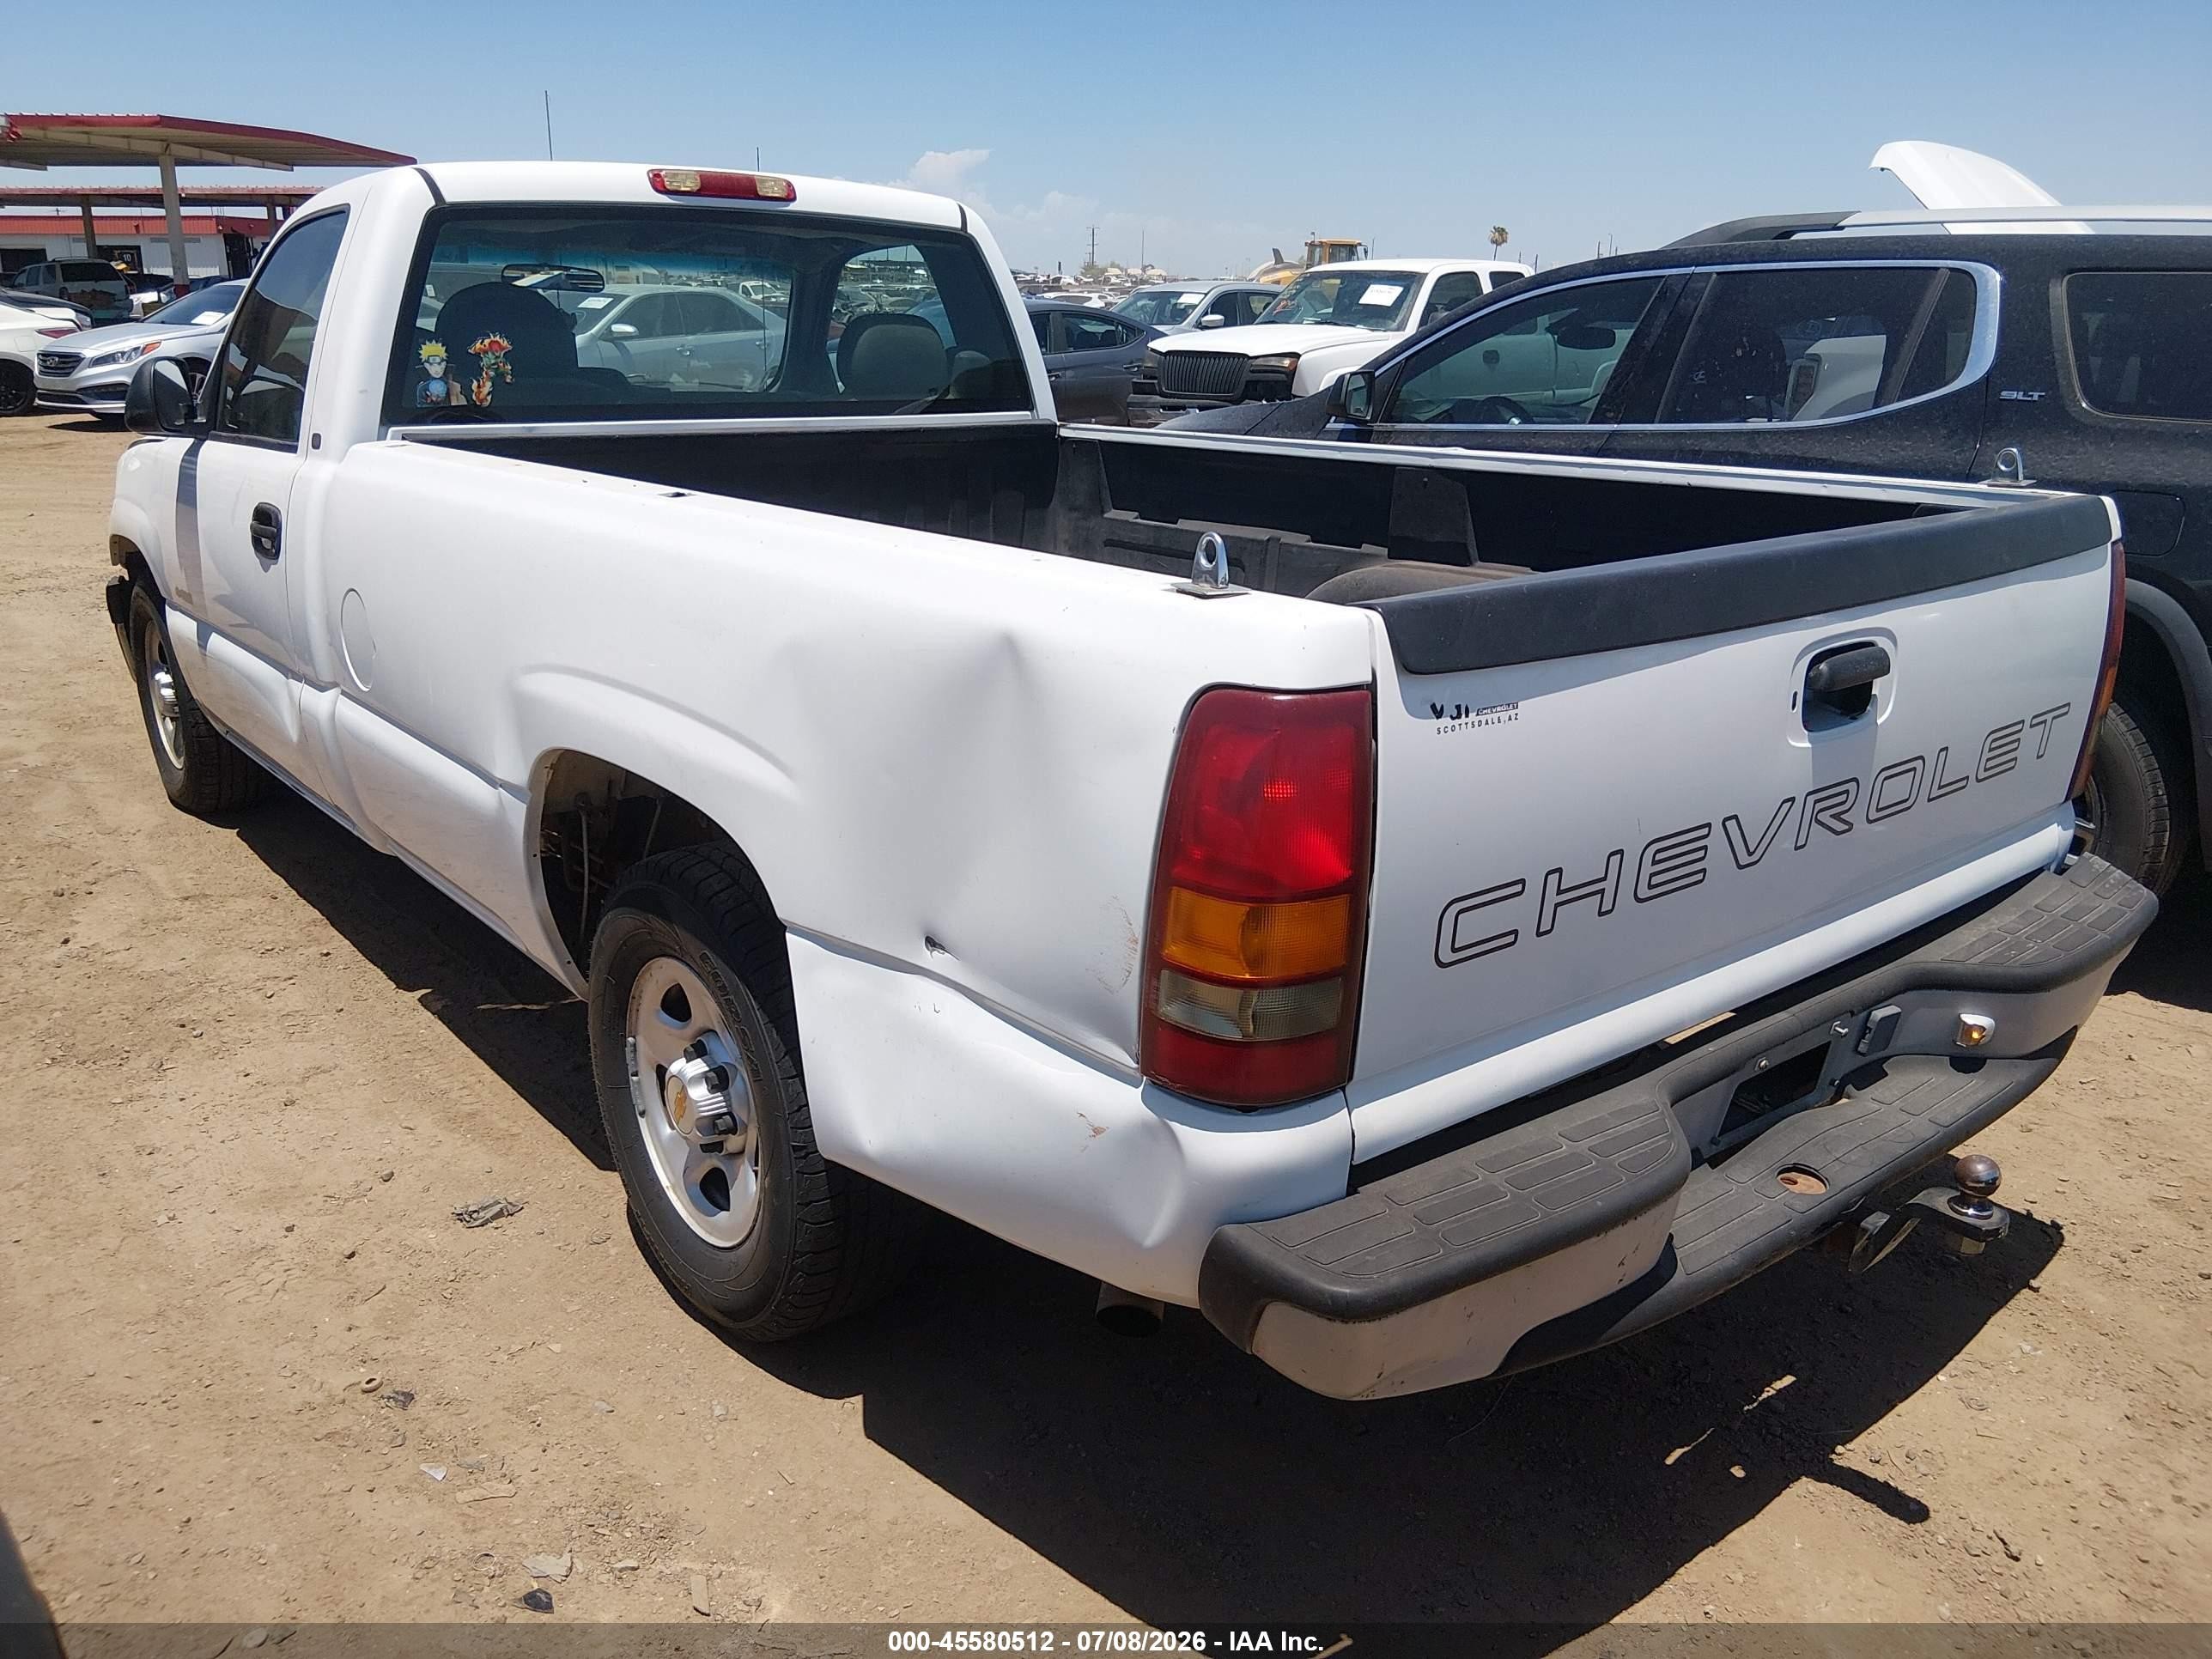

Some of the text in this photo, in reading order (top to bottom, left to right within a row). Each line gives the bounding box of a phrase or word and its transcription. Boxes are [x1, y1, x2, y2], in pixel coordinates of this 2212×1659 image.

[1999, 391, 2045, 401] SLT
[1477, 702, 1518, 716] CHEVROLET
[1435, 702, 2070, 969] CHEVROLET
